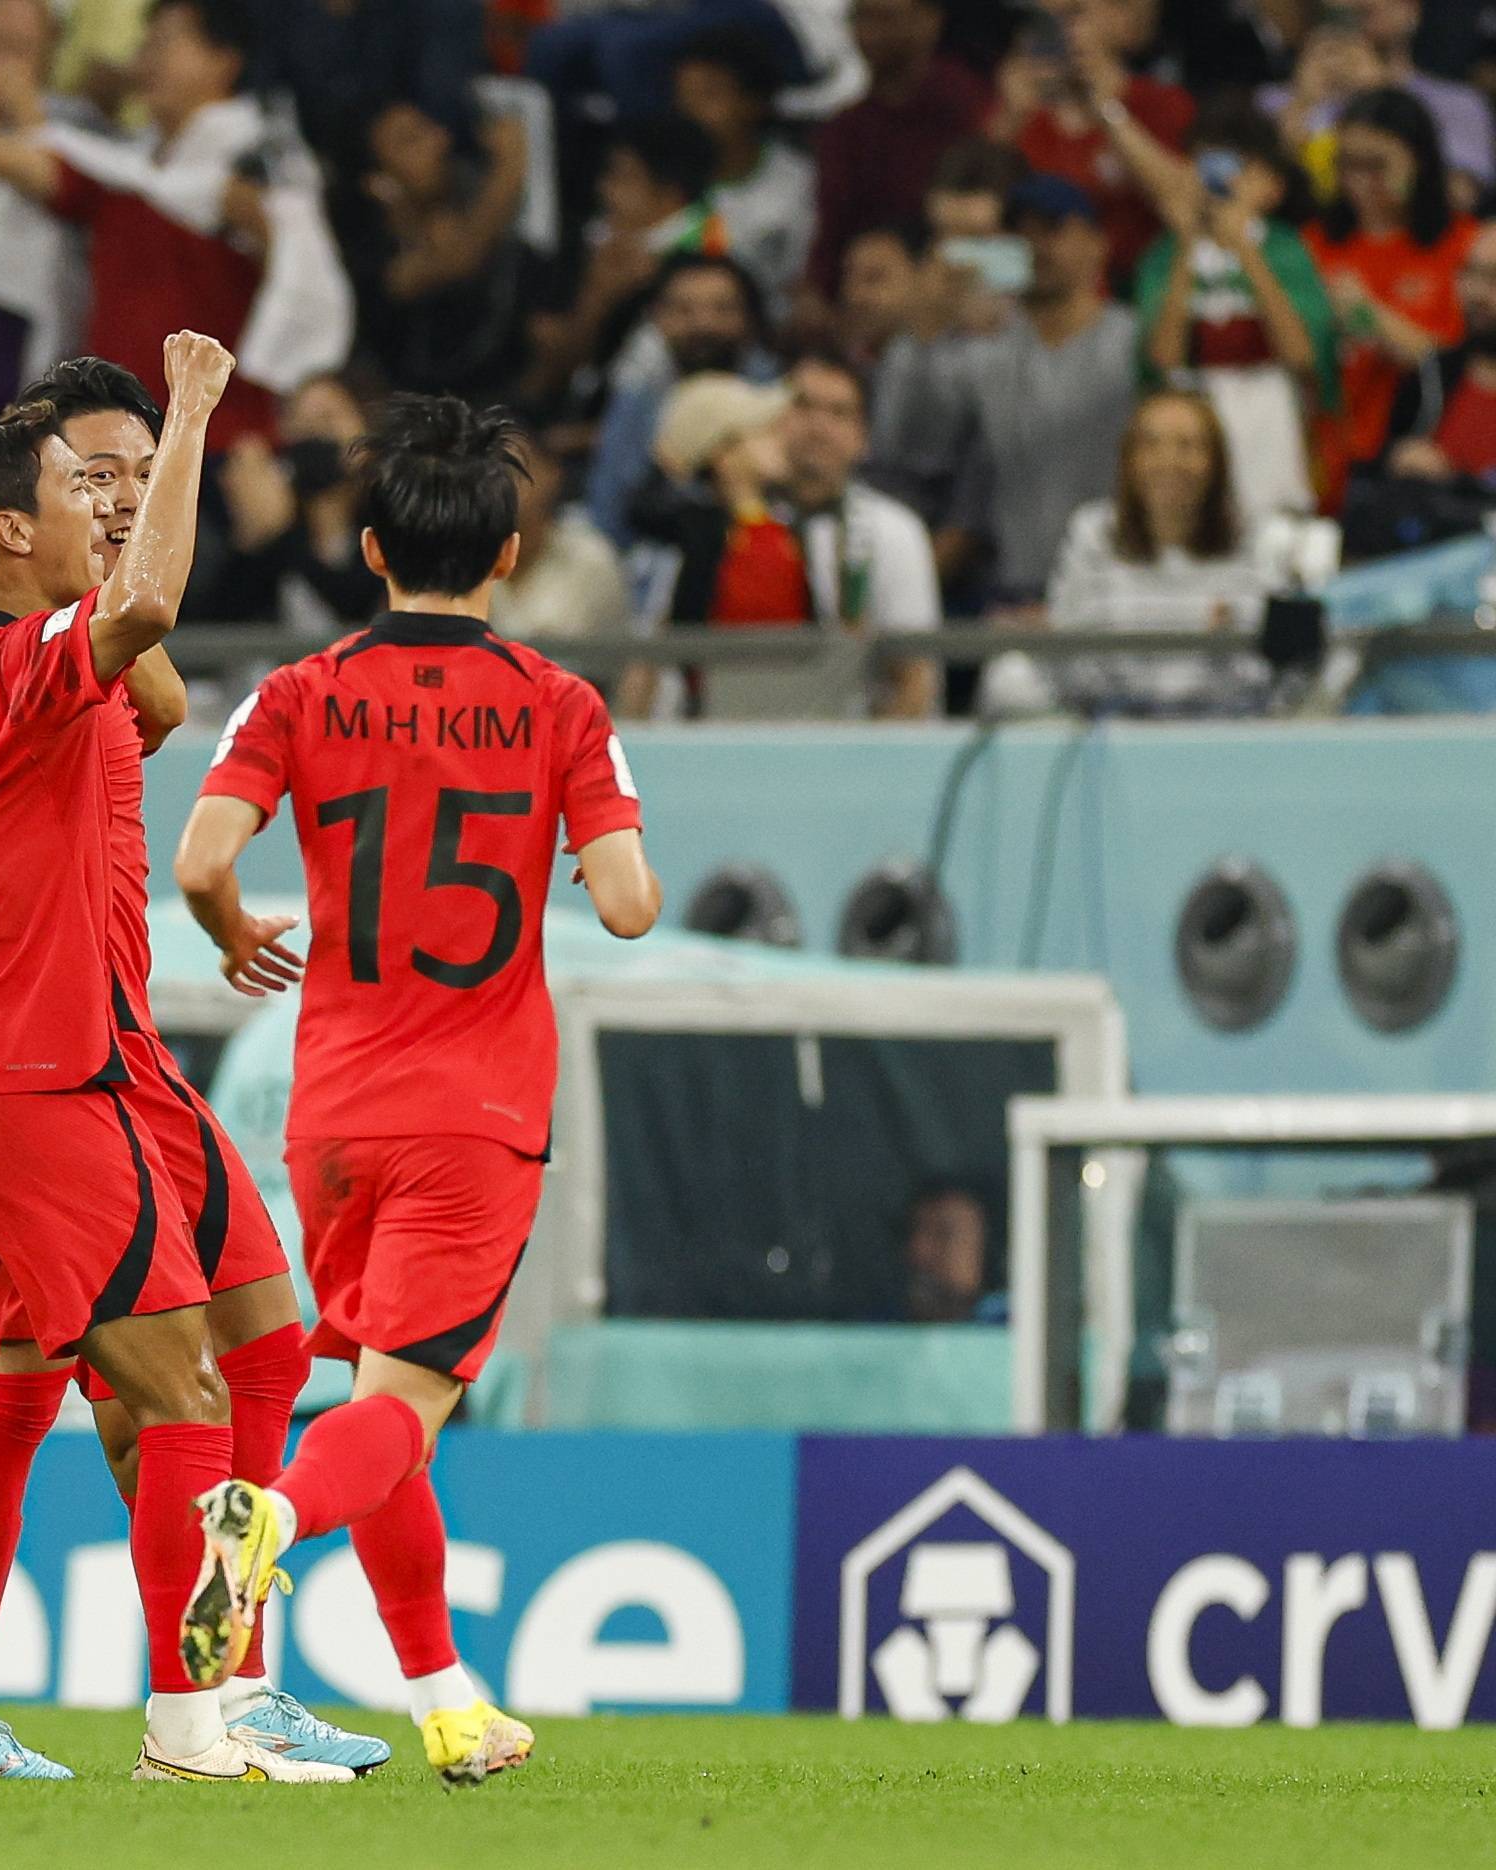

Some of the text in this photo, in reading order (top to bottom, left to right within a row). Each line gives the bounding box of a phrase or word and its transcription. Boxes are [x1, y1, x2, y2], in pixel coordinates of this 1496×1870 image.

[324, 695, 533, 750] M H KIM
[316, 785, 533, 990] 15
